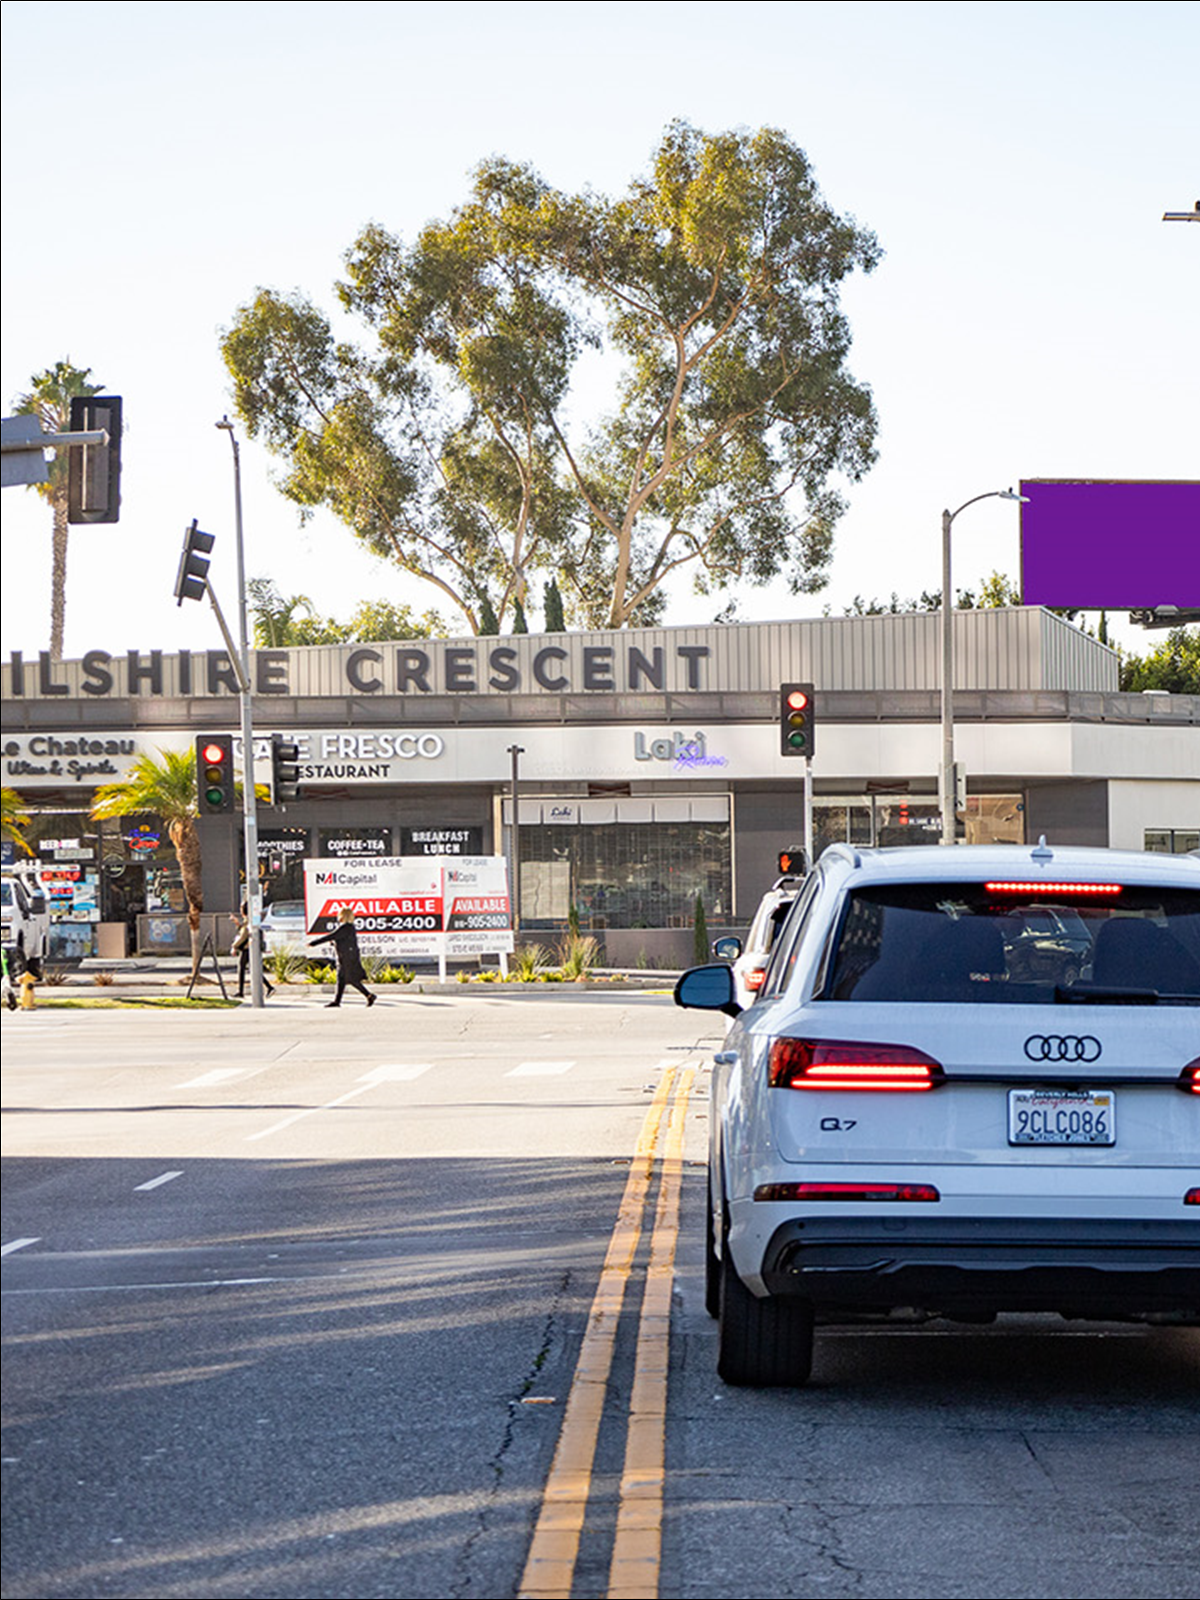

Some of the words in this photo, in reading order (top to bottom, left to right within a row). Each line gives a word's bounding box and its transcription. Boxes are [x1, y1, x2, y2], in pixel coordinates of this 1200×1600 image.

[11, 649, 291, 696] ILSHIRE
[345, 646, 710, 693] CRESCENT
[1, 741, 20, 757] e
[29, 736, 134, 756] Chateau
[321, 733, 445, 760] FRESCO
[634, 731, 707, 761] Laki
[298, 764, 391, 779] ESTAURANT
[412, 831, 470, 842] BREAKFAST
[257, 840, 305, 851] MOOTHIES
[424, 843, 461, 854] LUNCH
[344, 860, 366, 868] FOR
[369, 859, 402, 867] LEASE
[316, 871, 337, 884] NAI
[338, 873, 377, 885] Capital
[328, 900, 435, 914] AVAILABLE
[455, 899, 506, 912] AVAILABLE
[360, 946, 383, 955] EISS
[820, 1117, 857, 1131] Q7
[1018, 1110, 1107, 1134] 9CLC086
